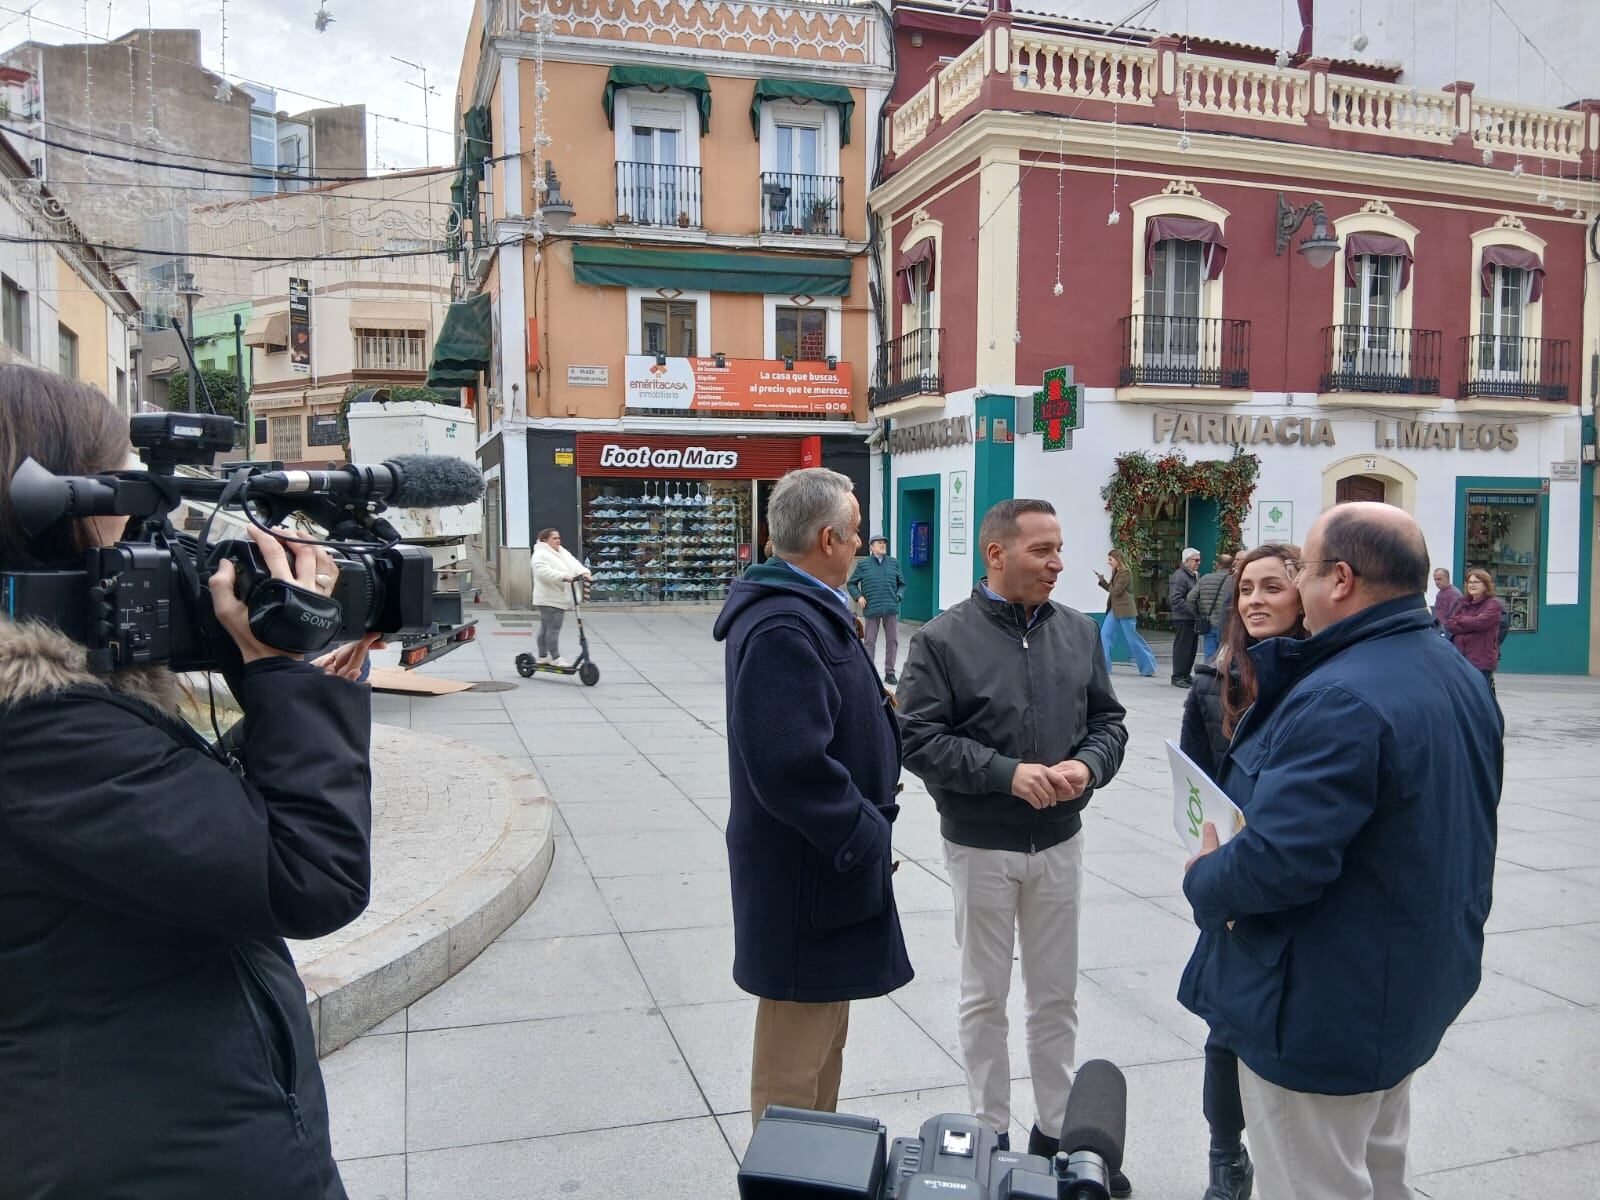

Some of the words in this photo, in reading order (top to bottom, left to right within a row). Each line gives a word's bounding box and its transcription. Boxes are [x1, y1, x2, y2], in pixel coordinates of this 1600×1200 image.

[792, 374, 808, 382] que
[810, 372, 840, 382] buscas,
[749, 384, 758, 392] al
[759, 384, 784, 395] precio
[786, 386, 802, 396] que
[804, 386, 812, 394] te
[814, 386, 850, 395] mereces.
[891, 415, 973, 456] FARMACIA
[1153, 414, 1335, 447] FARMACIA
[1397, 420, 1519, 451] MATEOS
[603, 447, 649, 466] Foot
[653, 452, 679, 466] on
[684, 449, 735, 466] Mars
[1365, 459, 1376, 469] 74
[300, 612, 333, 629] SONY
[1185, 776, 1203, 838] VOX
